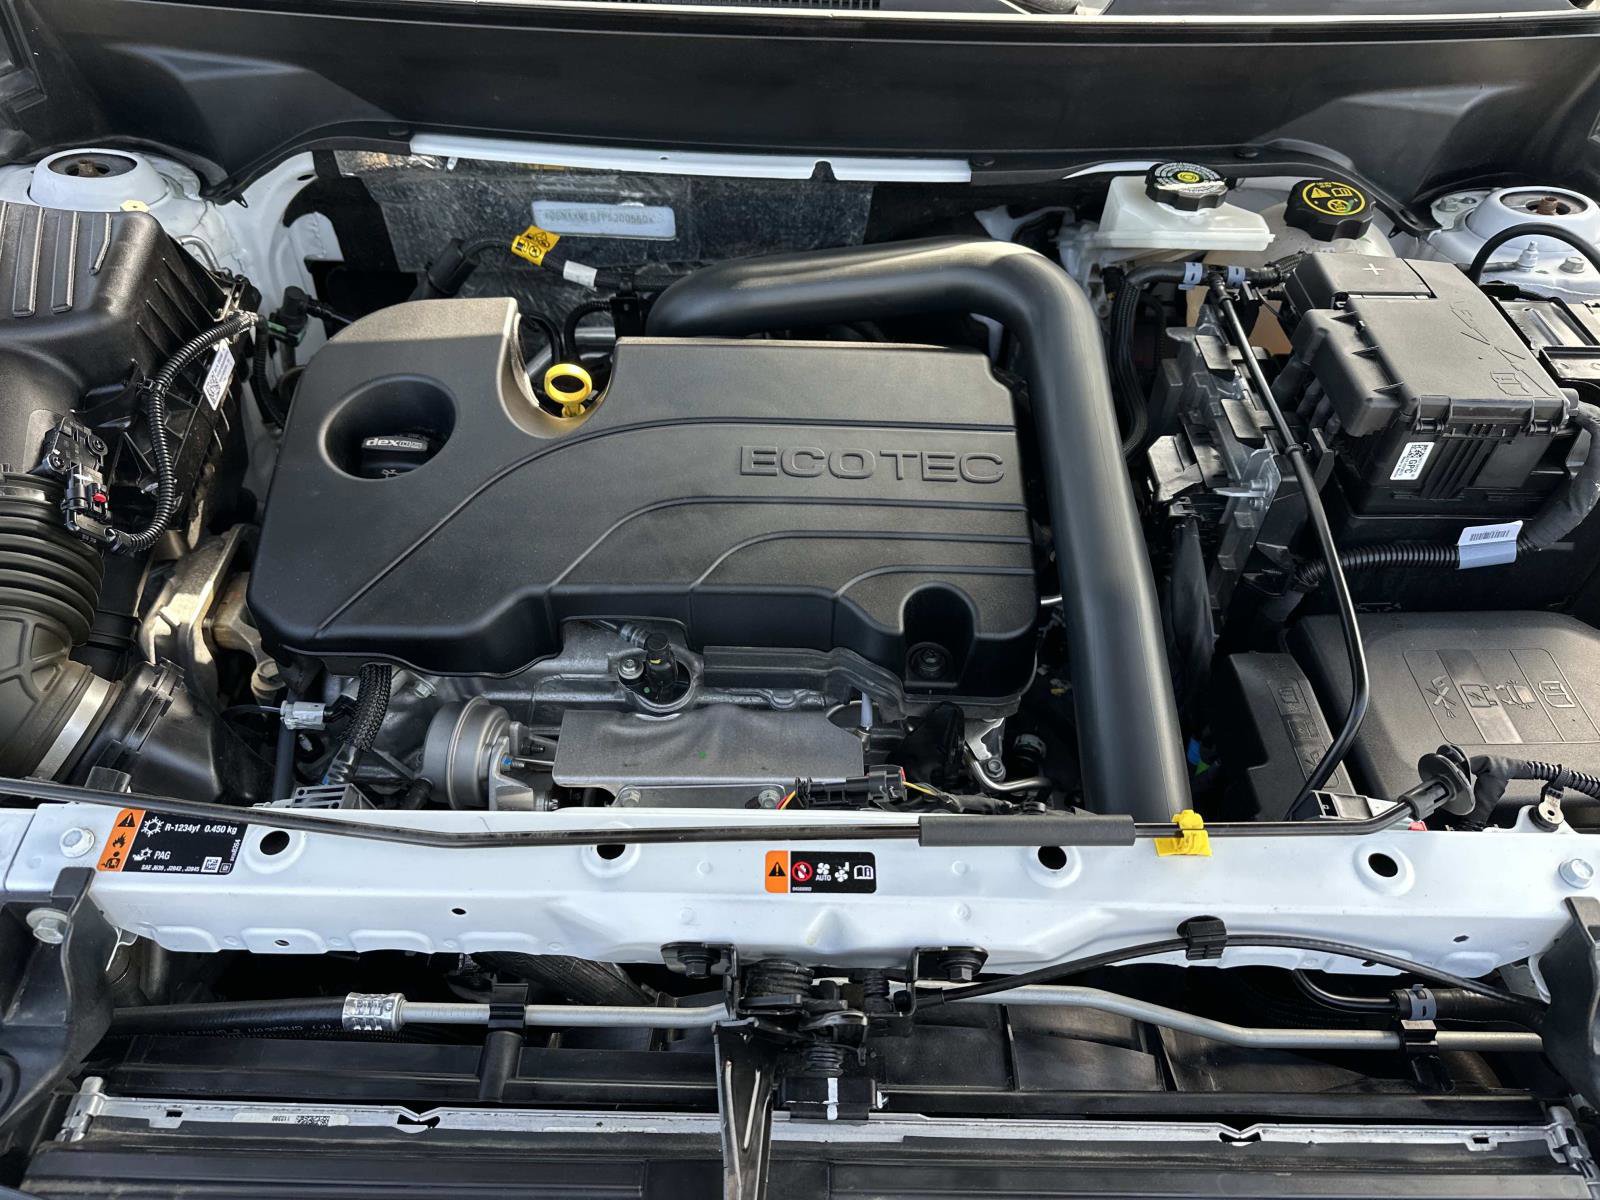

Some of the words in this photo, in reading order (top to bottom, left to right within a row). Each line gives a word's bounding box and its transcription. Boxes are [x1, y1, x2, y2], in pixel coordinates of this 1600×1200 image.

[740, 445, 1004, 484] ECOTEC
[1404, 459, 1418, 474] GPC
[165, 823, 201, 834] R-1234yf
[204, 825, 226, 833] 0.450
[227, 826, 238, 836] kg
[154, 850, 171, 860] PAG
